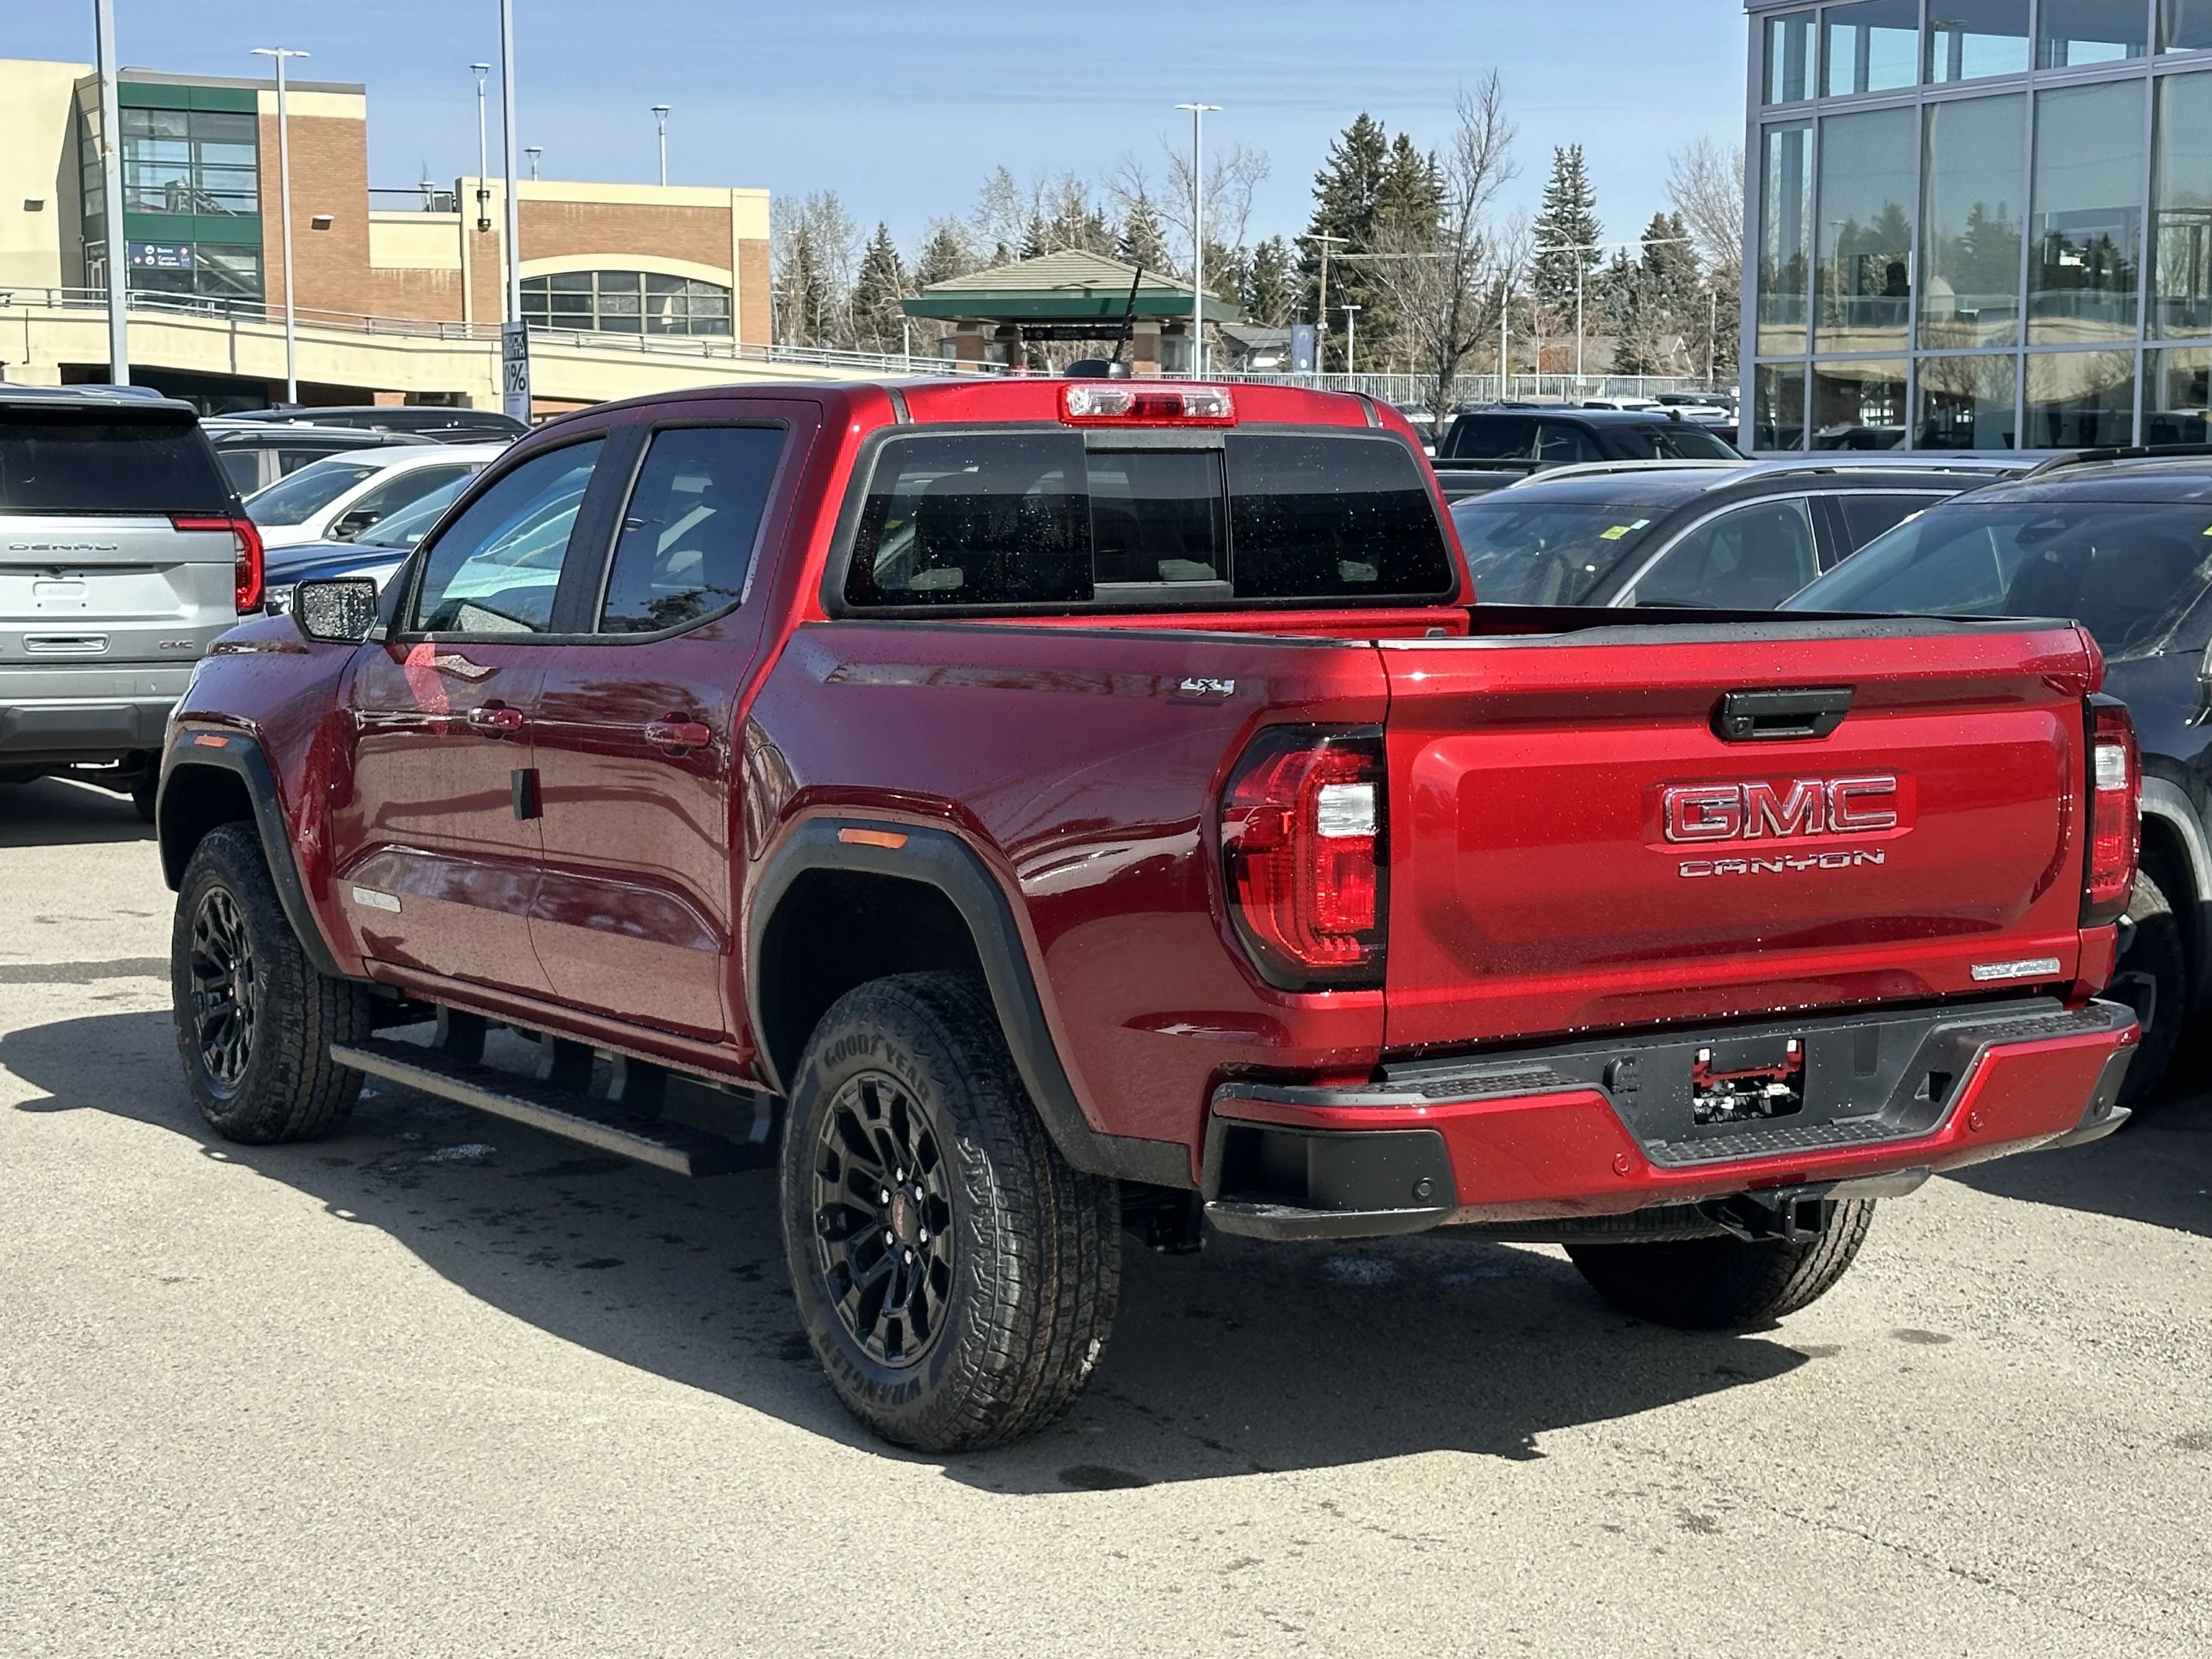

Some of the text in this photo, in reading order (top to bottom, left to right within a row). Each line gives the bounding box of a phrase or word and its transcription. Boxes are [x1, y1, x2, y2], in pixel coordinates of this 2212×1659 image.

[505, 363, 526, 392] 0%
[9, 542, 118, 550] DENALI
[159, 640, 194, 650] GMC
[1663, 775, 1897, 843] GMC
[1678, 848, 1885, 877] CANYON
